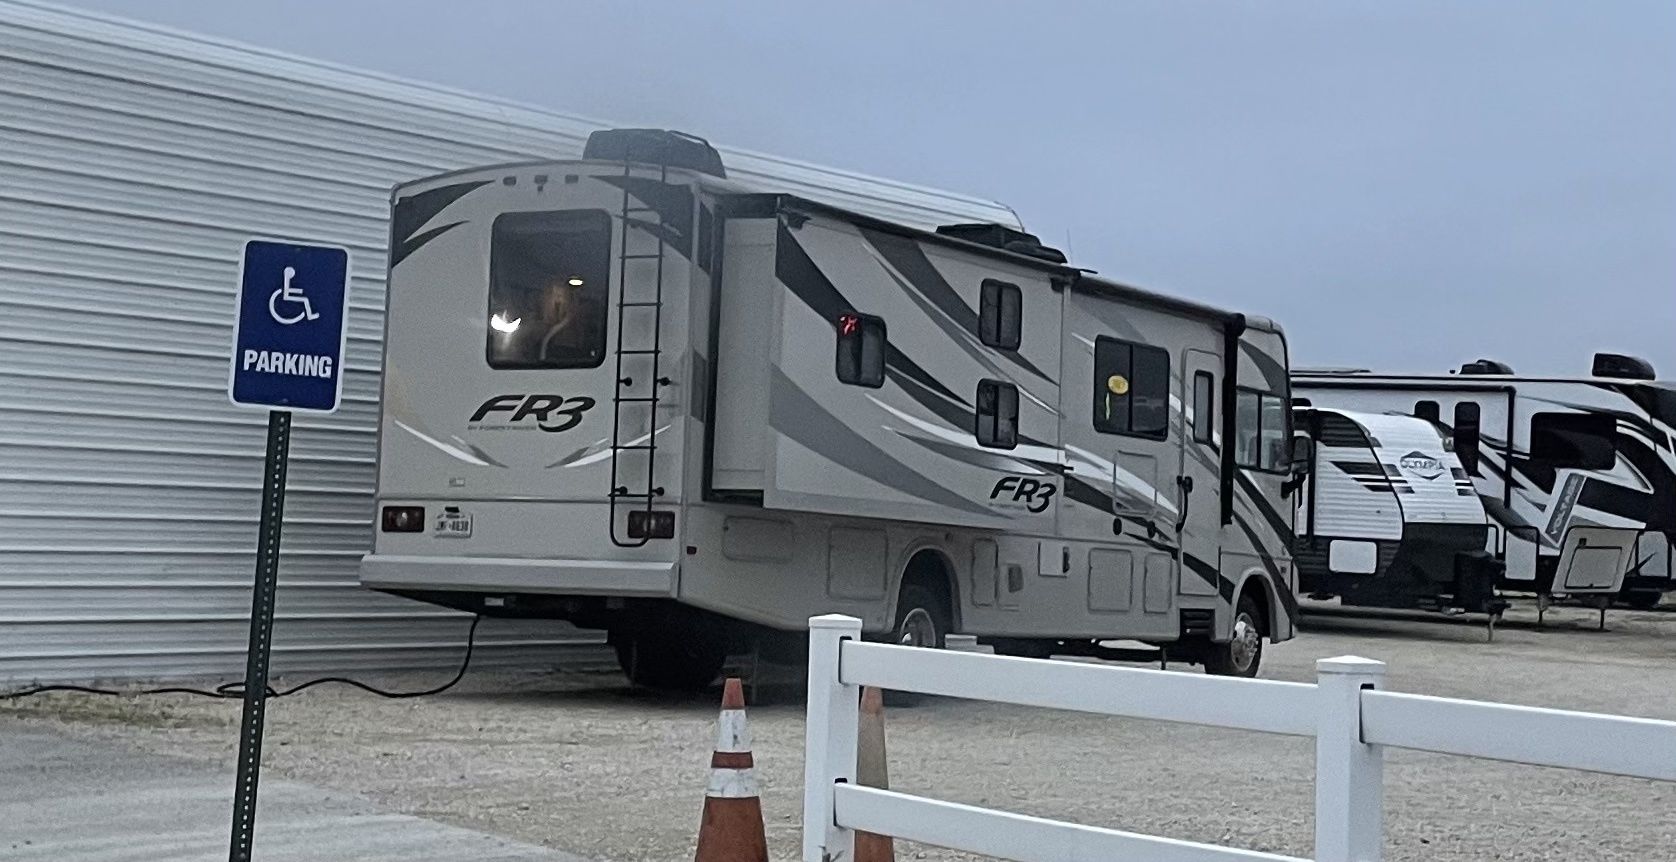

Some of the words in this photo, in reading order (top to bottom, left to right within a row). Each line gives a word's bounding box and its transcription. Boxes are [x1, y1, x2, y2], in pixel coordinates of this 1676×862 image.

[243, 349, 333, 379] PARKING
[469, 394, 596, 433] FR3
[989, 476, 1057, 513] FR3
